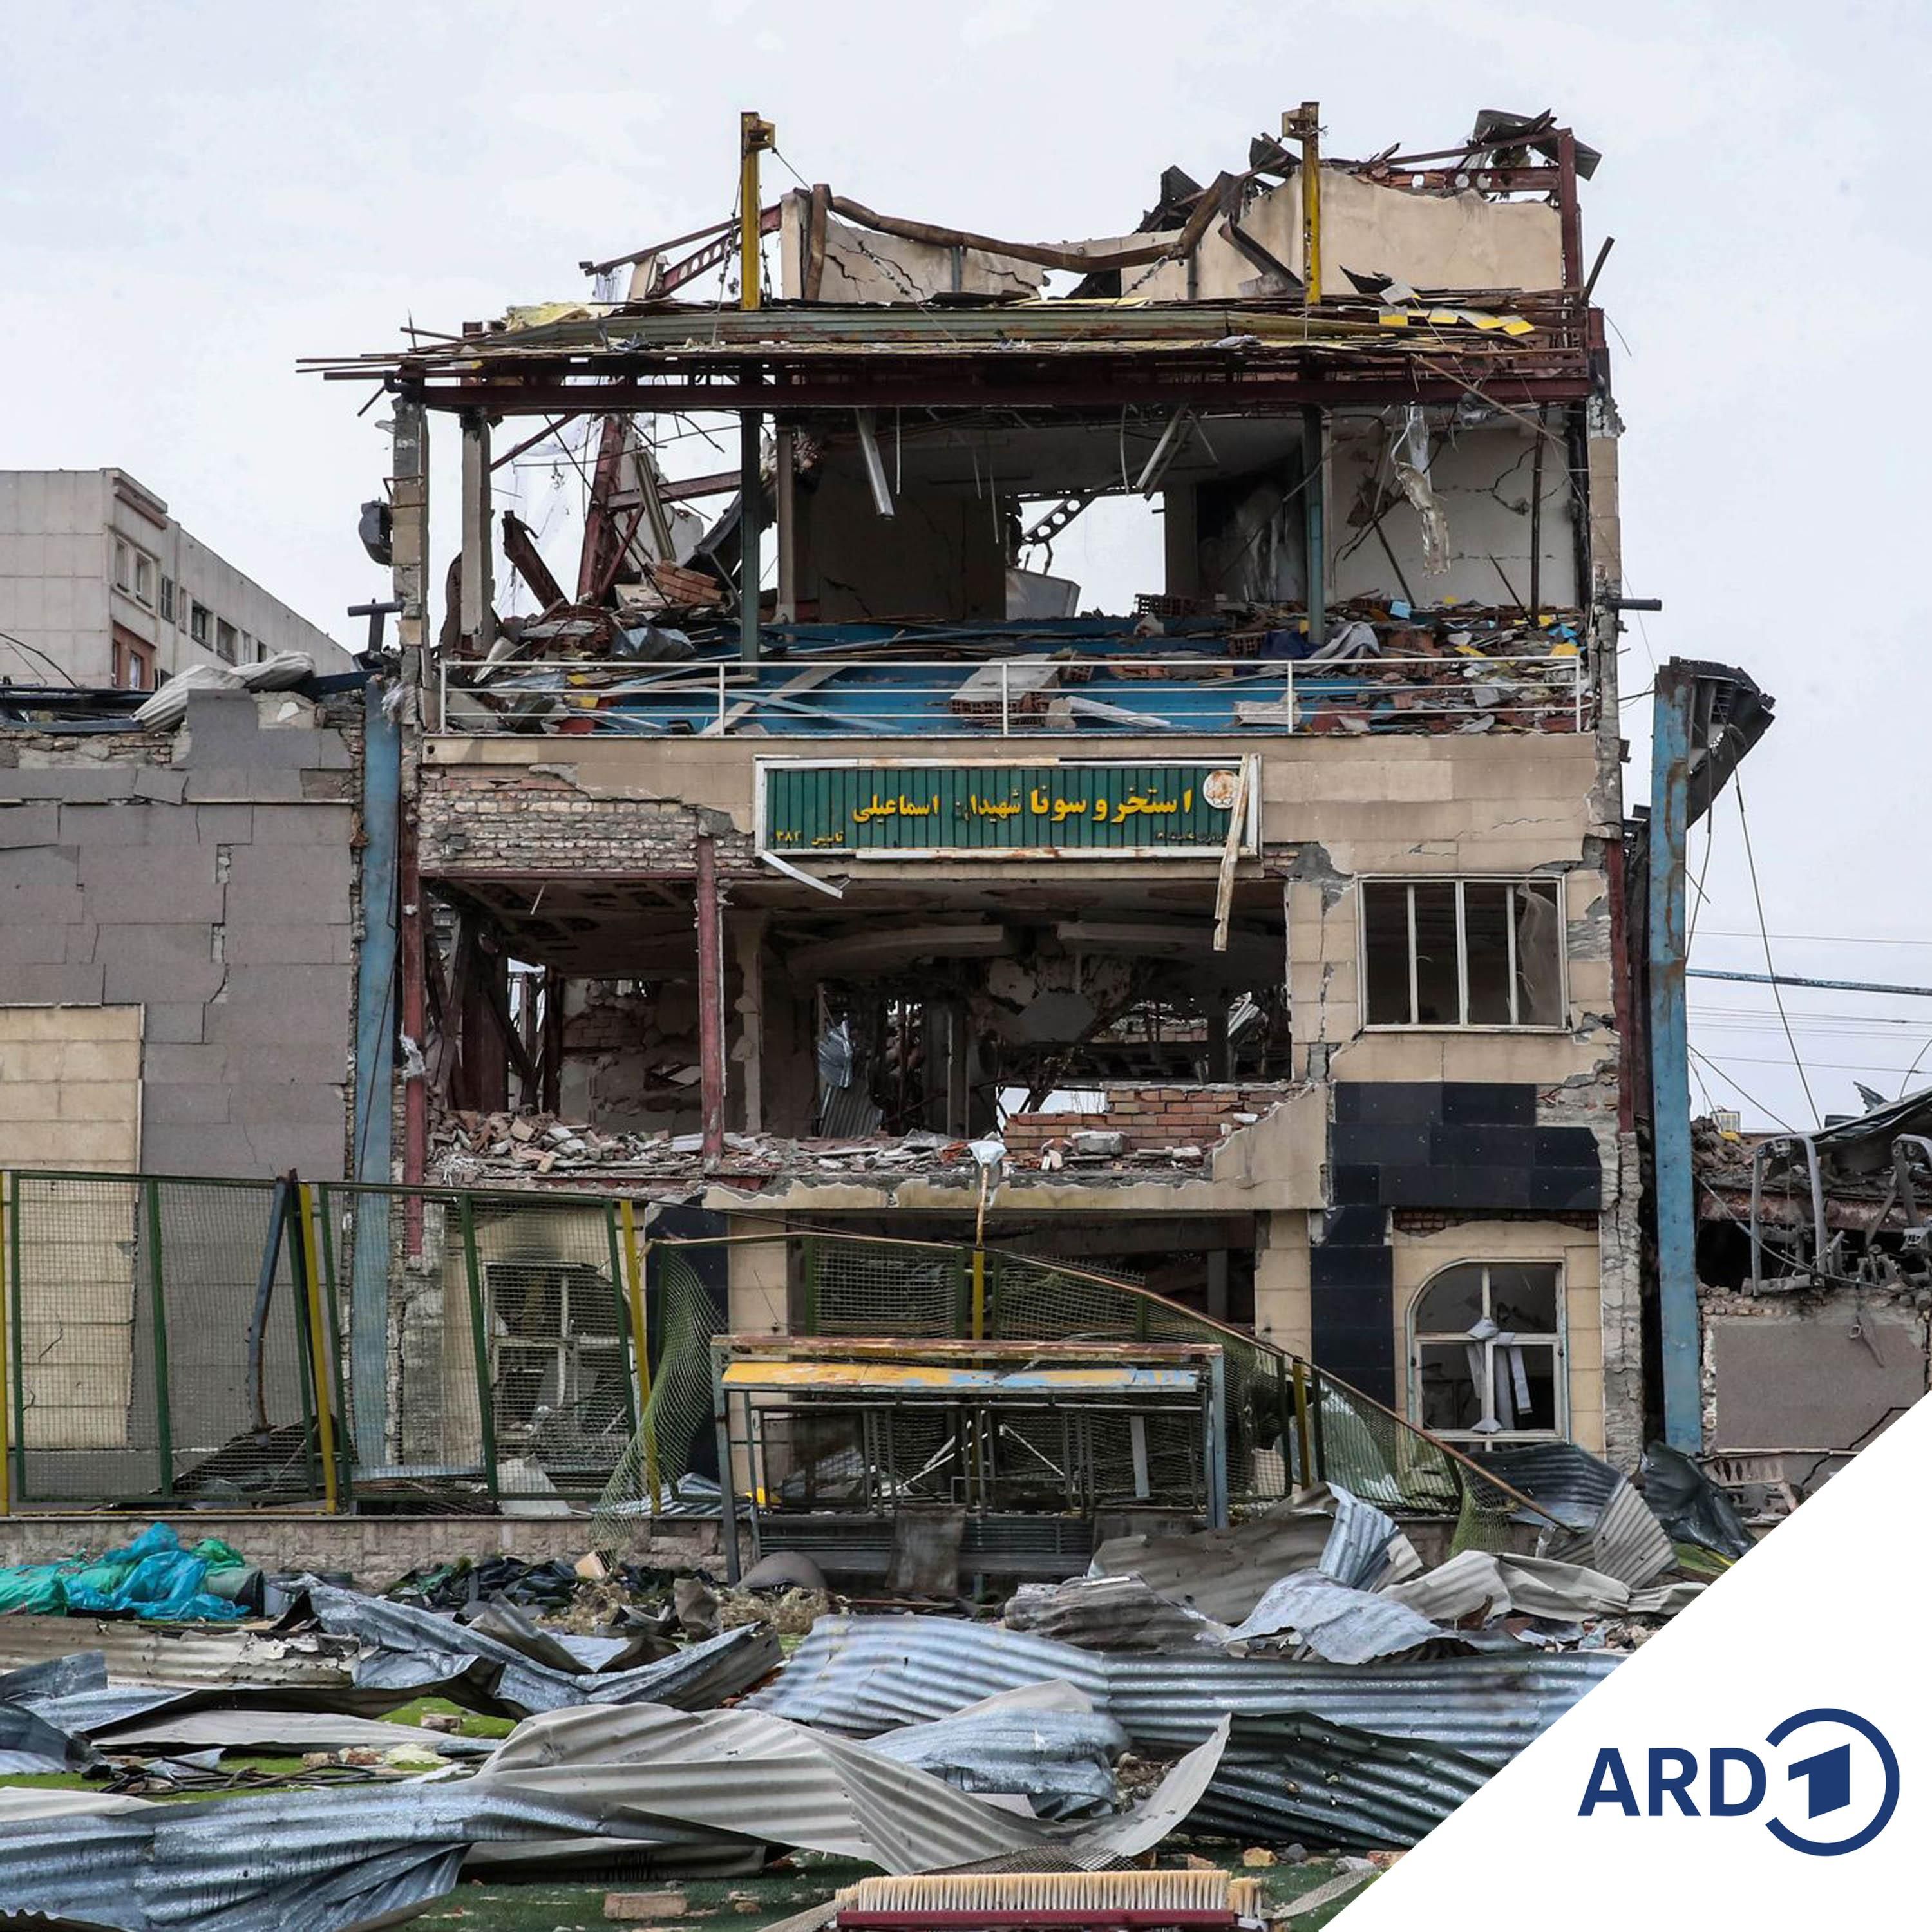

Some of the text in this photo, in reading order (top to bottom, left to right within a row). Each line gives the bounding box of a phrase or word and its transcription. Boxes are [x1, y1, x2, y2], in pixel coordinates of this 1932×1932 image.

[853, 793, 940, 824] اسماعیلی
[1030, 784, 1087, 822] سونا
[1092, 799, 1108, 822] و
[1111, 787, 1193, 823] استخر
